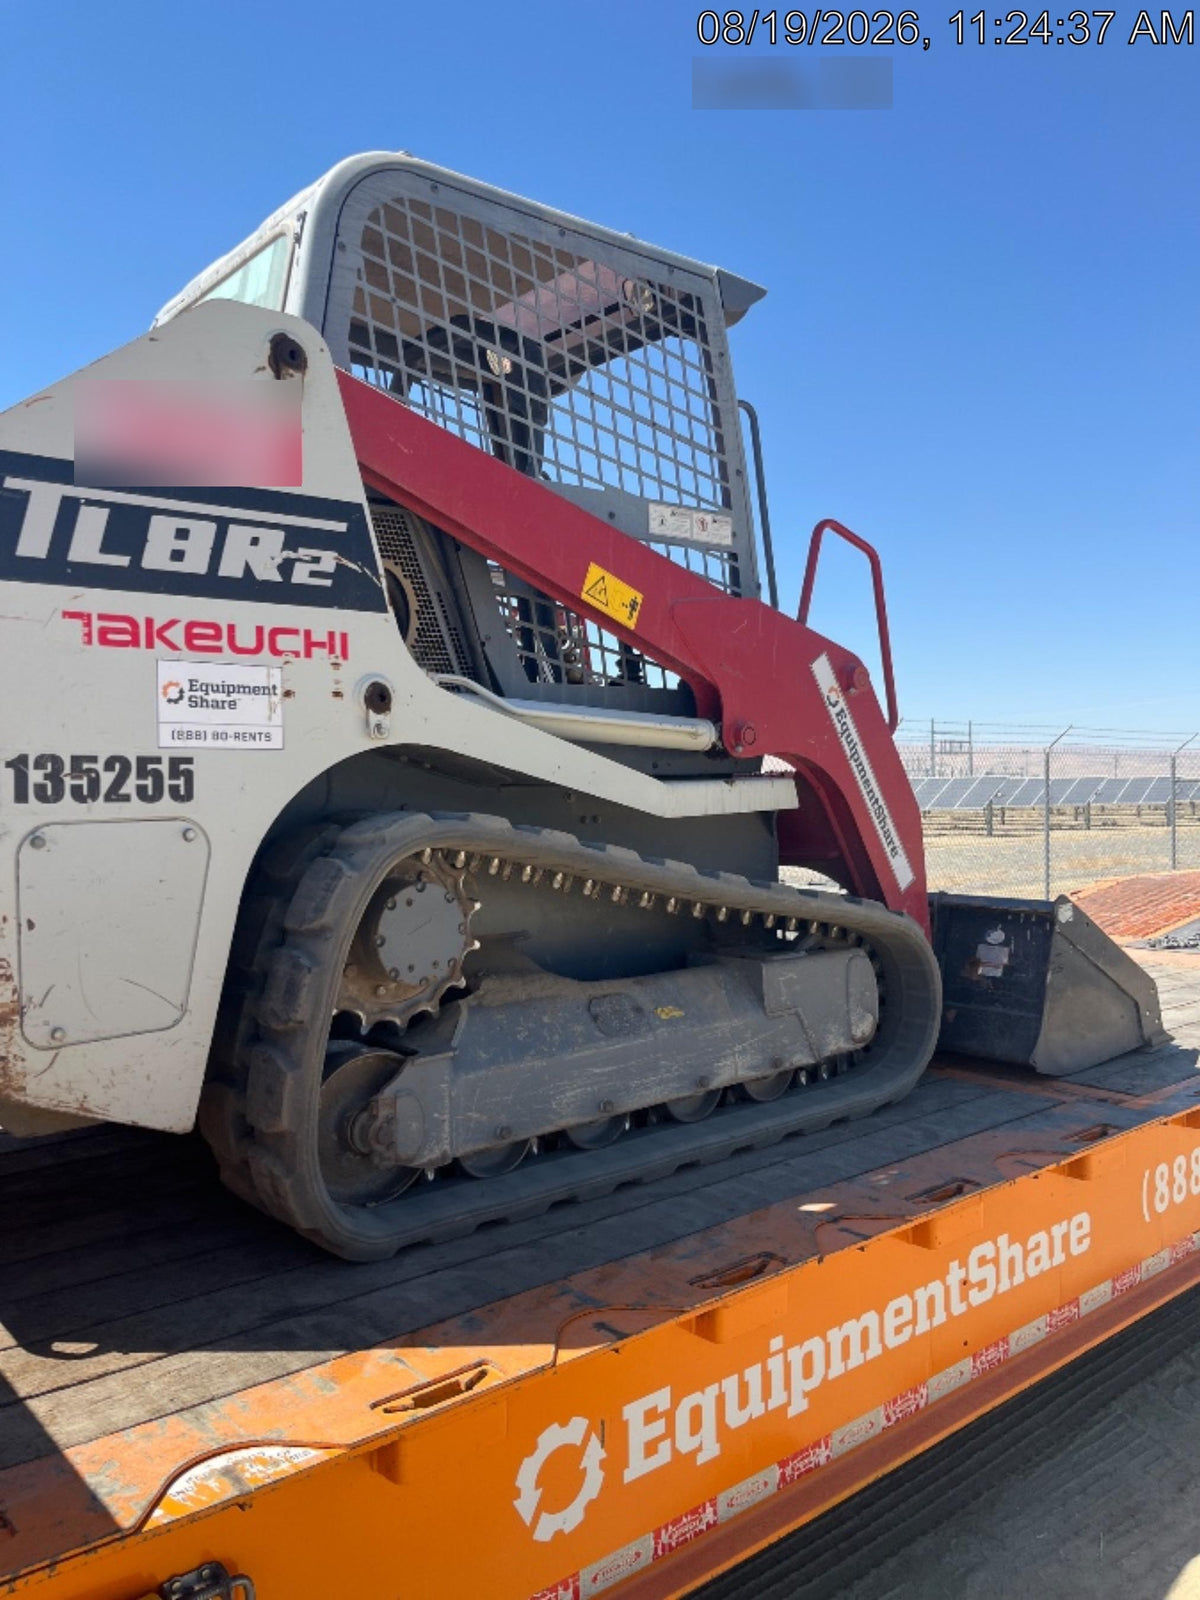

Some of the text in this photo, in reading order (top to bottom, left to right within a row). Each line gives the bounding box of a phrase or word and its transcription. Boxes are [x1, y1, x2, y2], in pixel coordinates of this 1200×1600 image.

[188, 678, 278, 698] Equipment
[188, 695, 237, 710] Share
[211, 731, 272, 743] 80-RENTS
[5, 753, 195, 804] 135255
[834, 706, 899, 859] EquipmentShare
[1142, 1146, 1200, 1223] (888
[622, 1211, 1092, 1484] EquipmentShare
